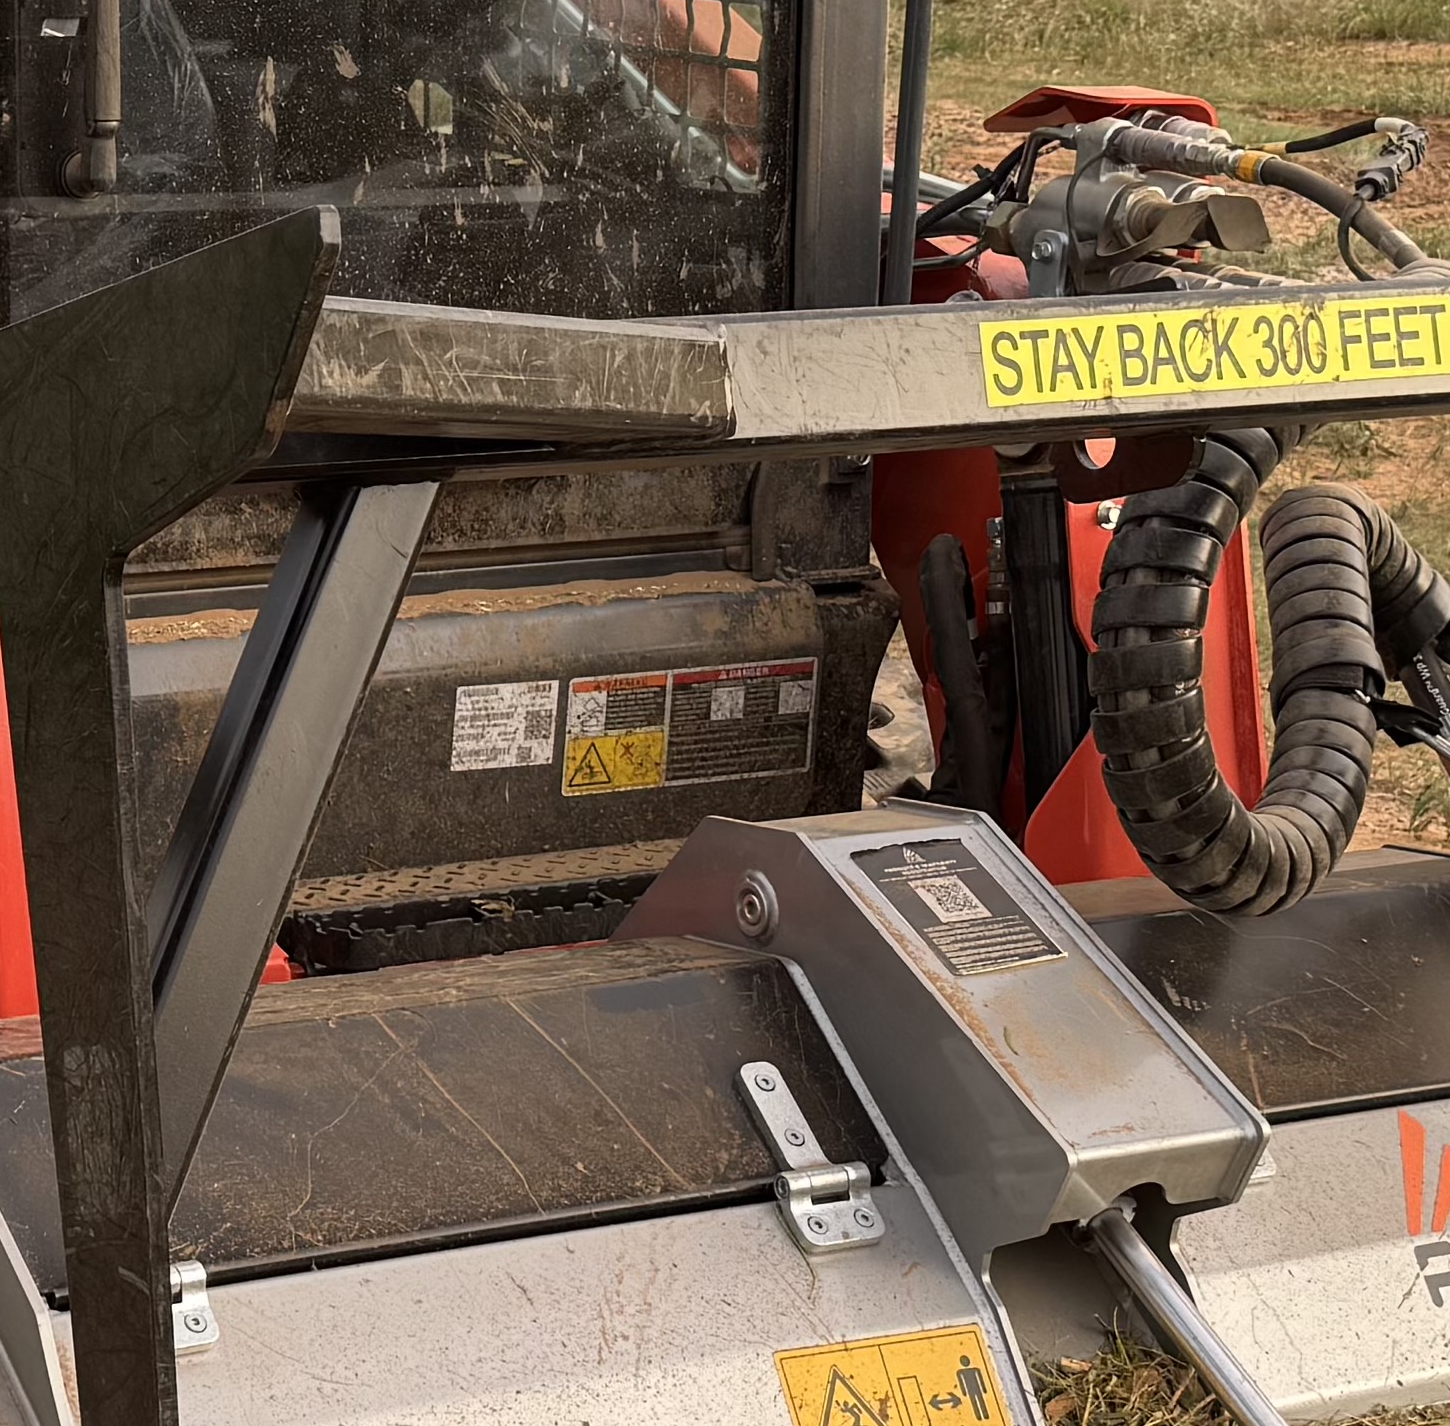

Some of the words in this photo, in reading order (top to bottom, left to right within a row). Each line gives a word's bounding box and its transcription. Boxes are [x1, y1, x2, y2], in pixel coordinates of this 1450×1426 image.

[991, 325, 1105, 396] STAY
[1118, 317, 1247, 387] BACK
[1254, 311, 1327, 377] 300
[1339, 304, 1447, 371] FEET
